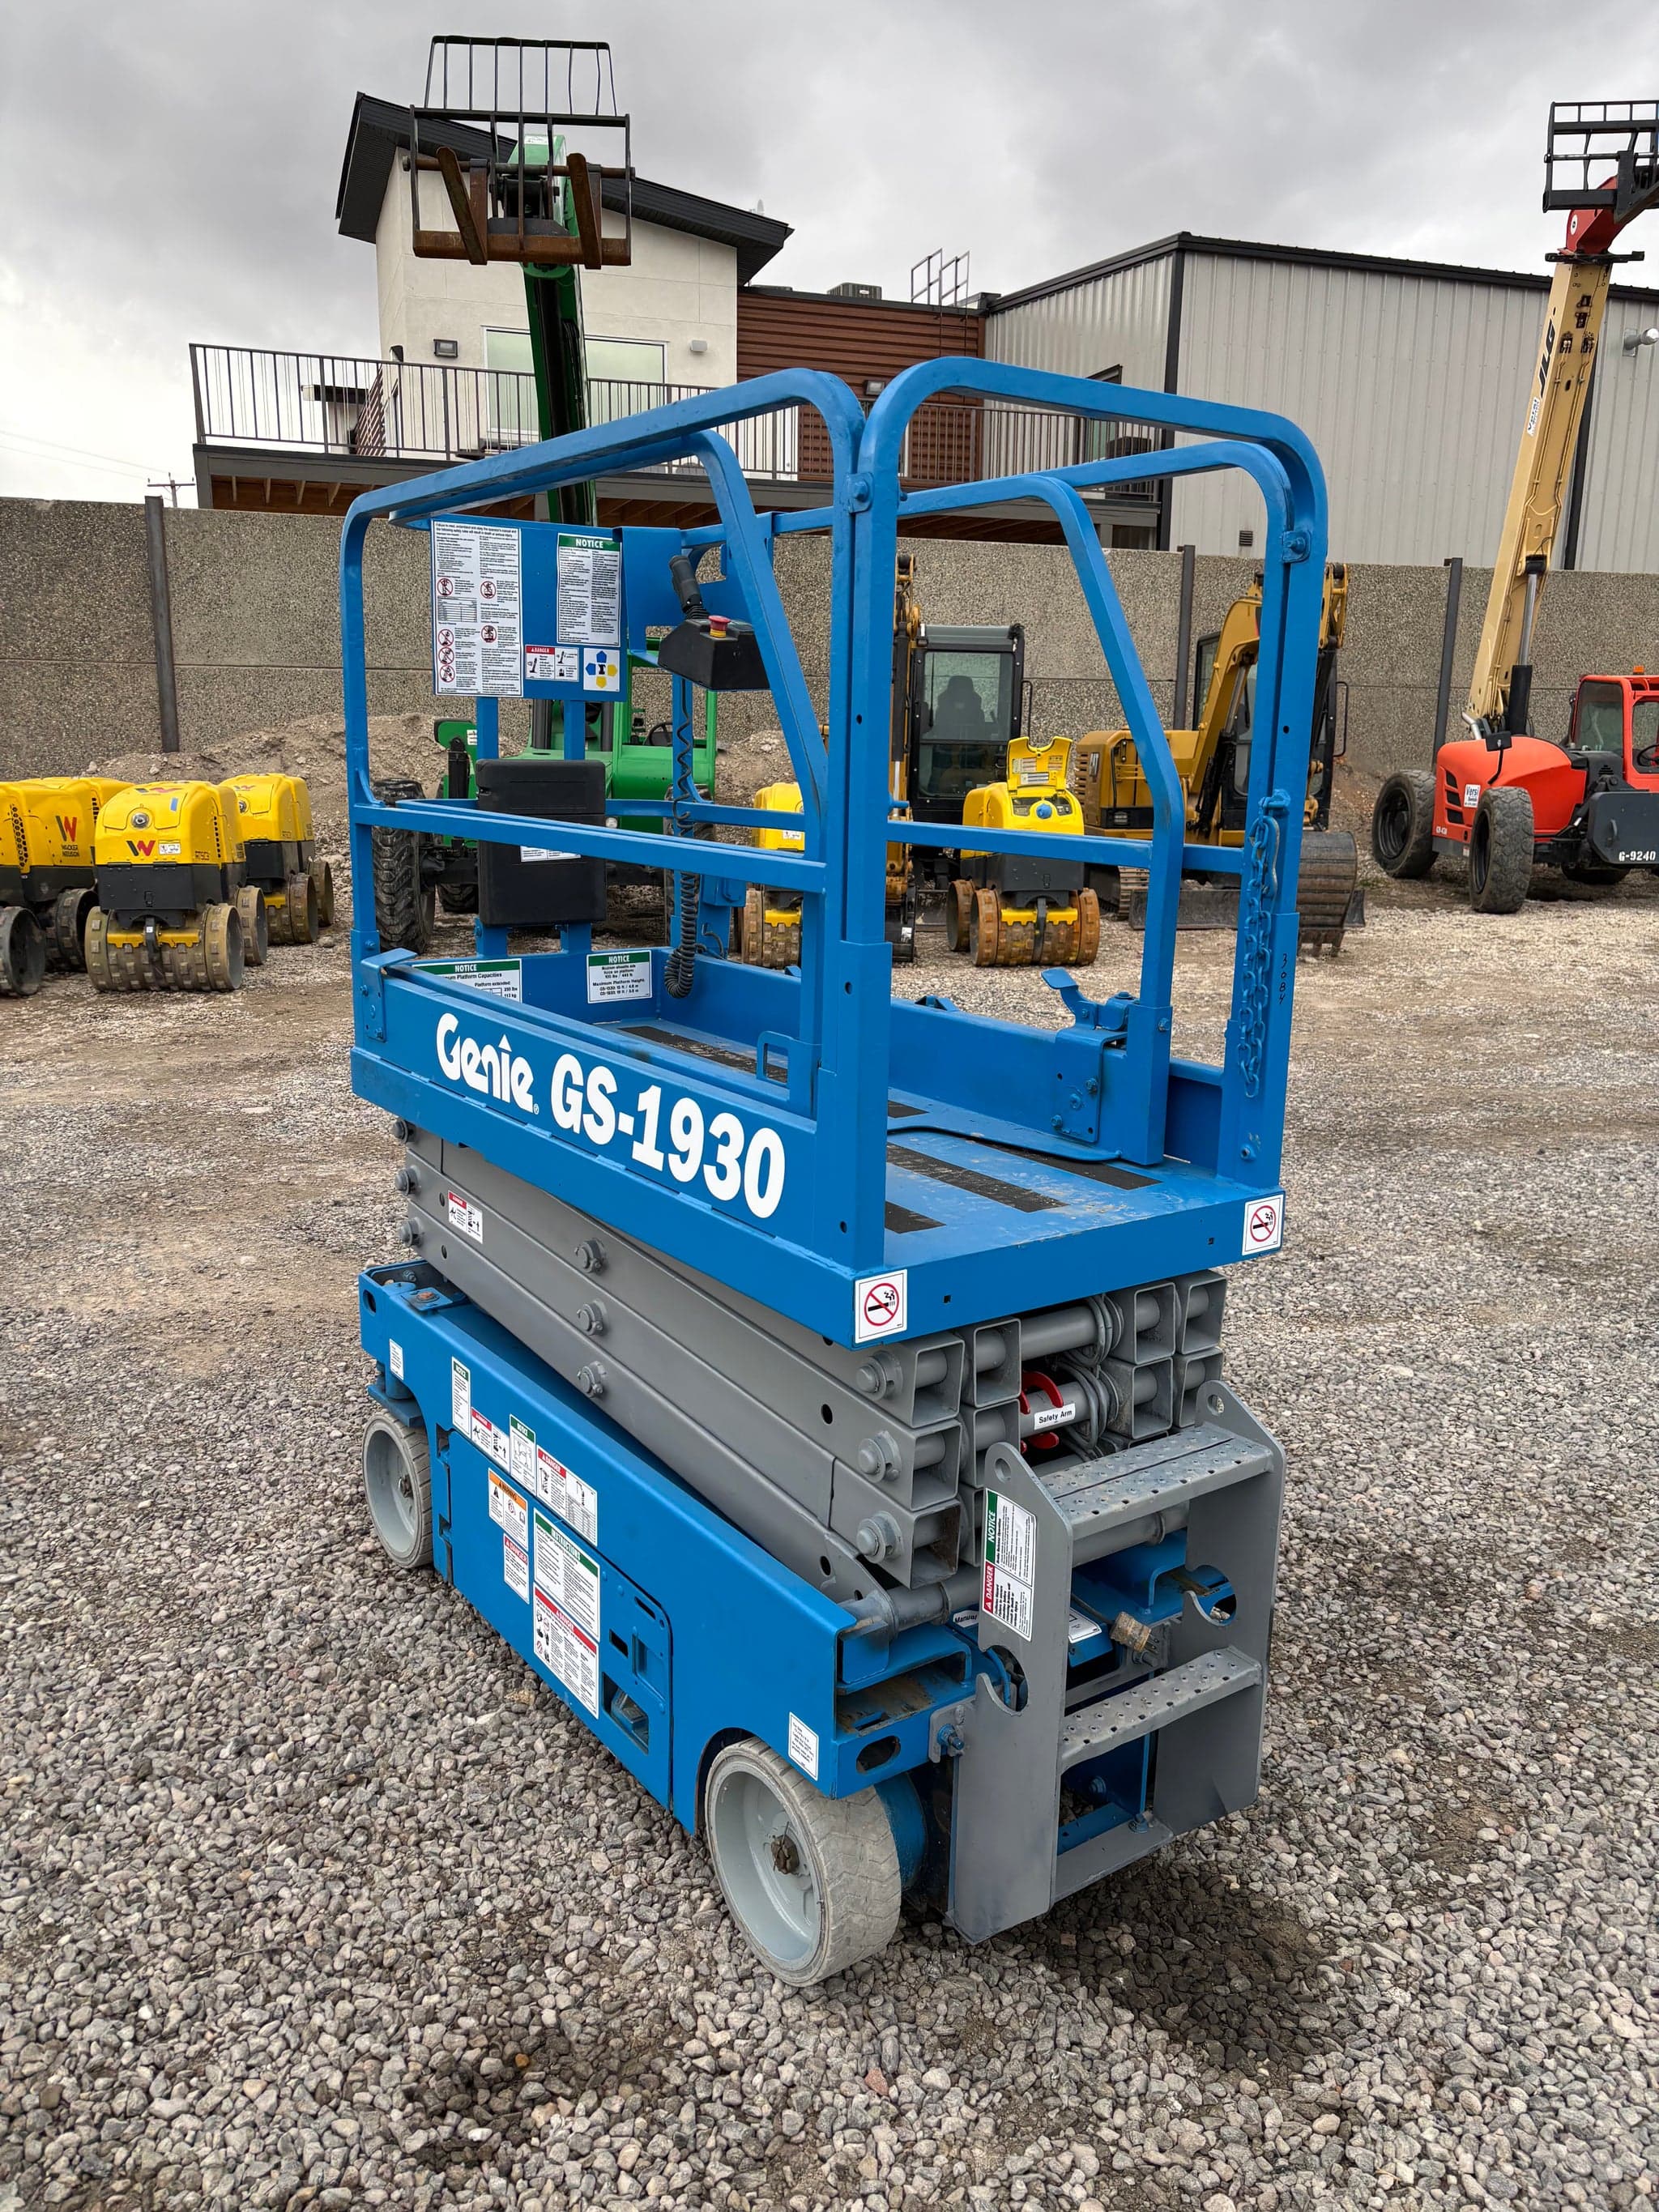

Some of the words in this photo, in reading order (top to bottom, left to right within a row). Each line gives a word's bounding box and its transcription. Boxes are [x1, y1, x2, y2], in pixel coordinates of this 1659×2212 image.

[1539, 318, 1555, 399] JLG
[575, 539, 603, 548] NOTICE
[454, 964, 478, 973] NOTICE
[608, 955, 630, 964] NOTICE
[436, 1012, 534, 1114] Genie
[551, 1054, 786, 1219] GS-1930
[1038, 1413, 1059, 1424] Safety
[1060, 1410, 1073, 1418] Arm
[987, 1510, 996, 1543] NOTICE
[986, 1566, 994, 1600] DANGER
